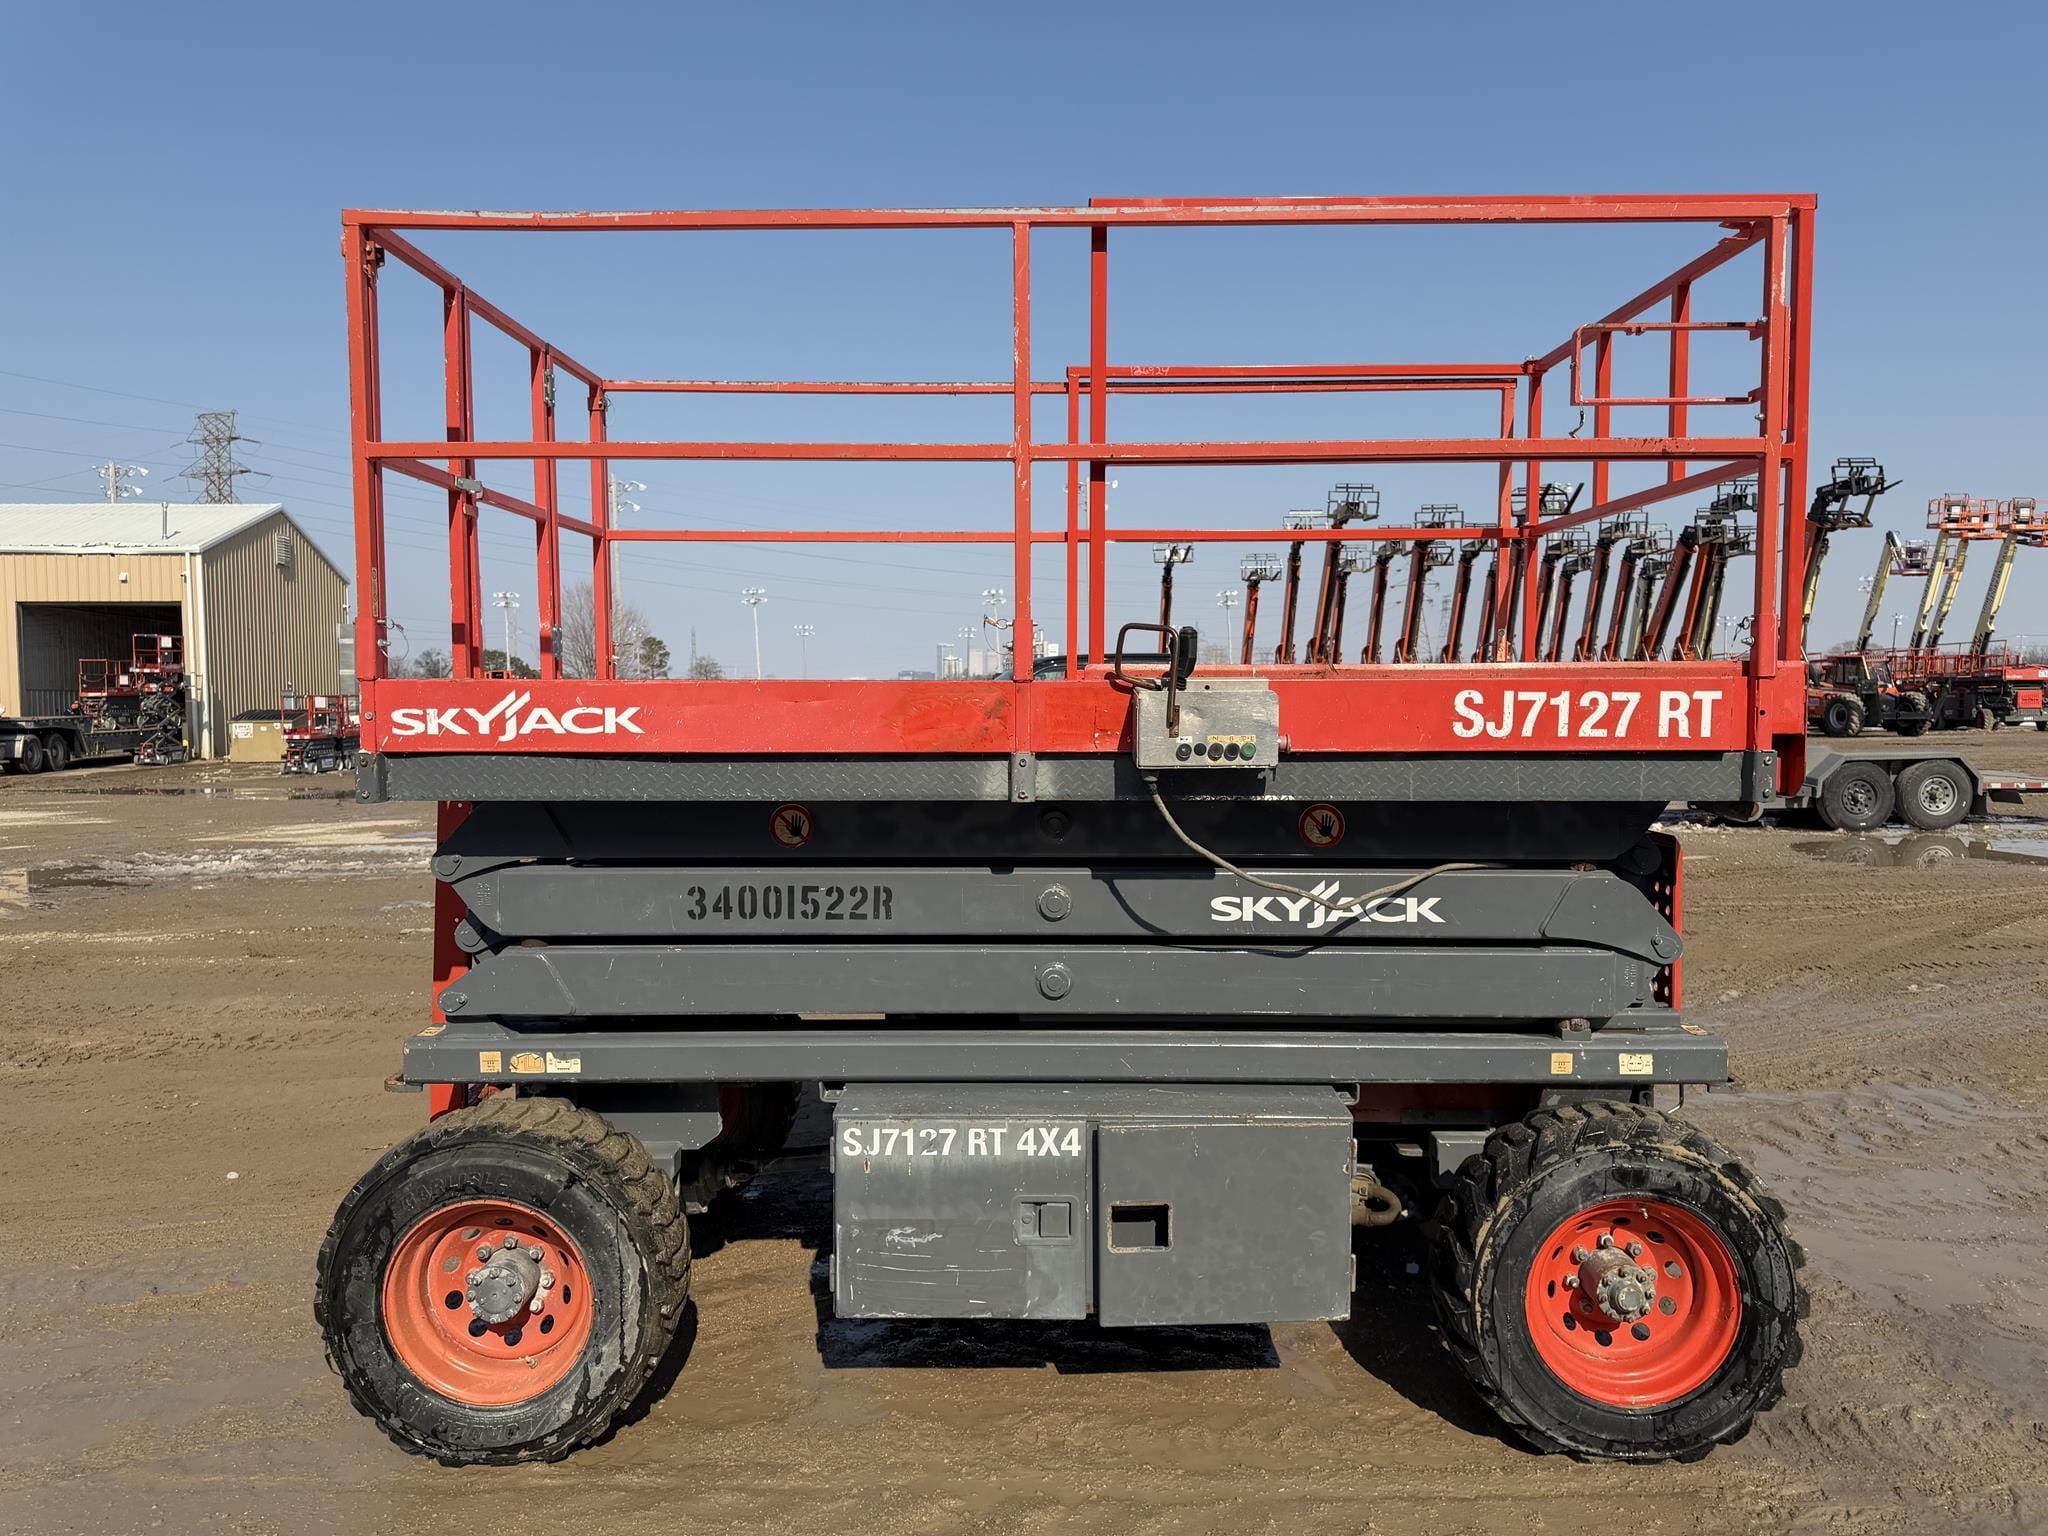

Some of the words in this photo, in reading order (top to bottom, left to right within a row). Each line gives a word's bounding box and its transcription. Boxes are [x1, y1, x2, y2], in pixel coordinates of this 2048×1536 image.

[390, 689, 646, 742] SKYJACK
[1452, 690, 1641, 738] SJ7127
[1658, 690, 1723, 738] RT
[1210, 880, 1447, 929] SKYJACK
[842, 1127, 958, 1157] SJ7127
[967, 1127, 1008, 1157] RT
[1016, 1127, 1082, 1157] 4X4
